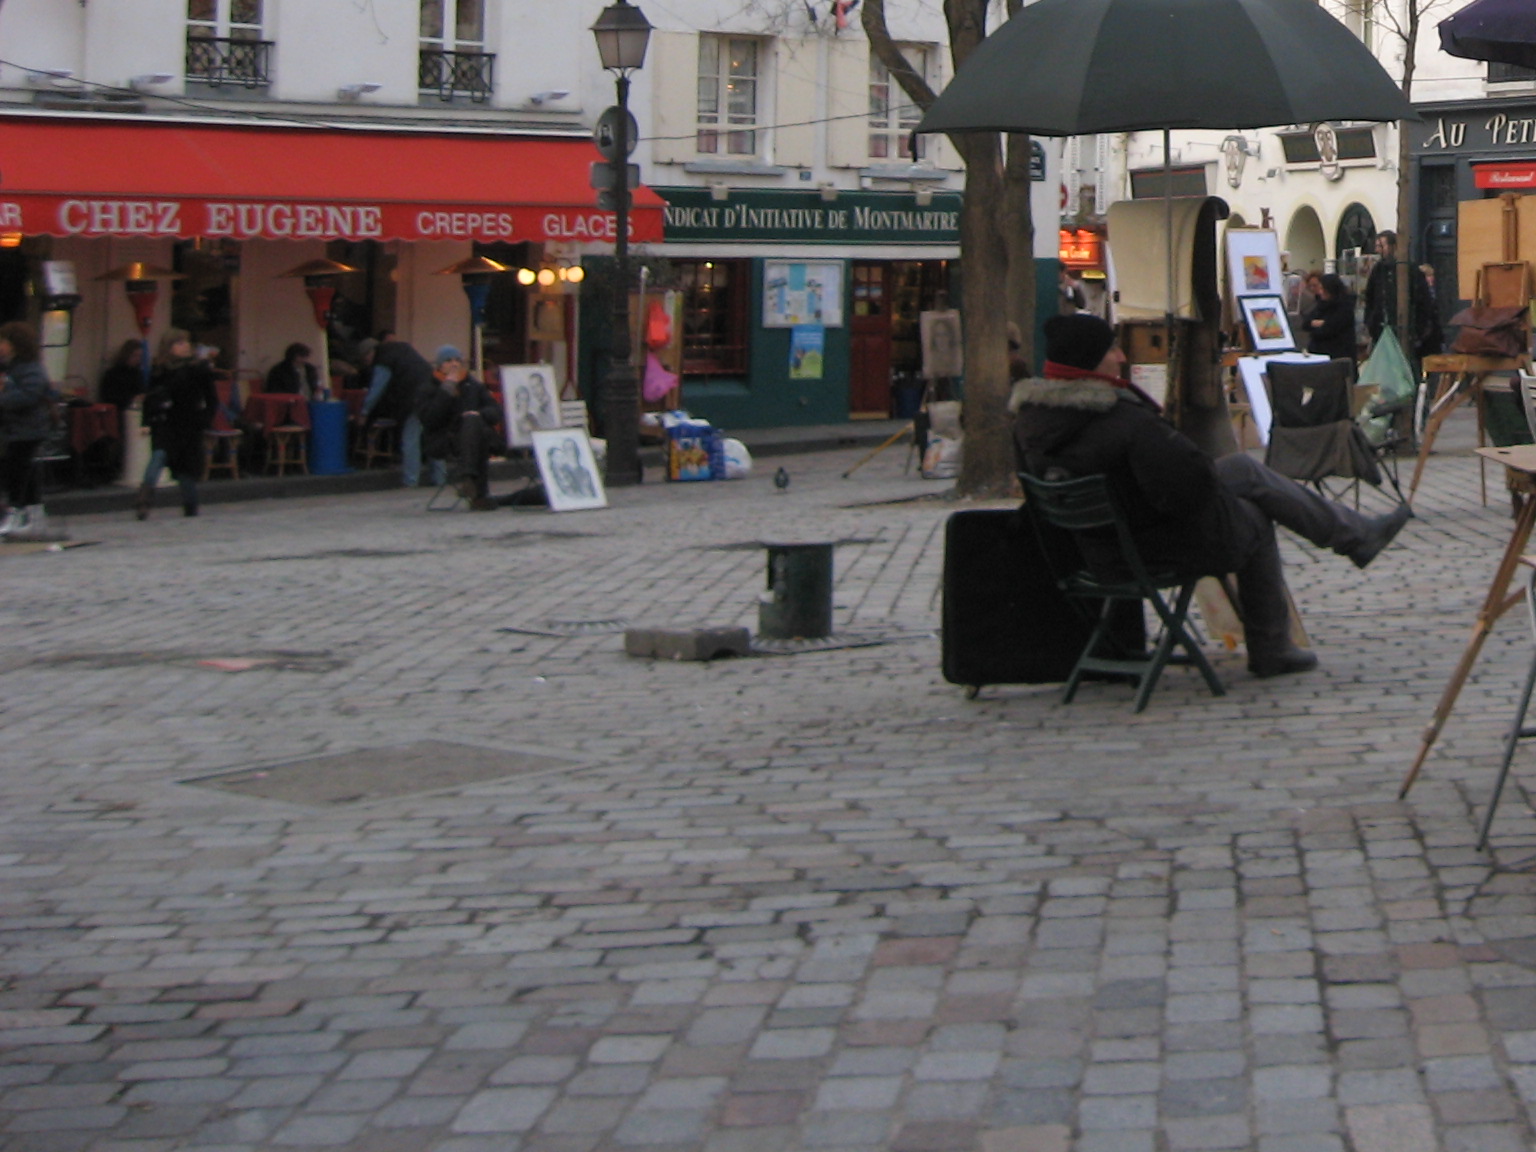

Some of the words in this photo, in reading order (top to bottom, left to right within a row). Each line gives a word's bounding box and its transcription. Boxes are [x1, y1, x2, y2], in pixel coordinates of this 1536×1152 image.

[57, 200, 182, 234] CHEZ
[206, 203, 383, 237] EUGENE
[417, 212, 513, 236] CREPES
